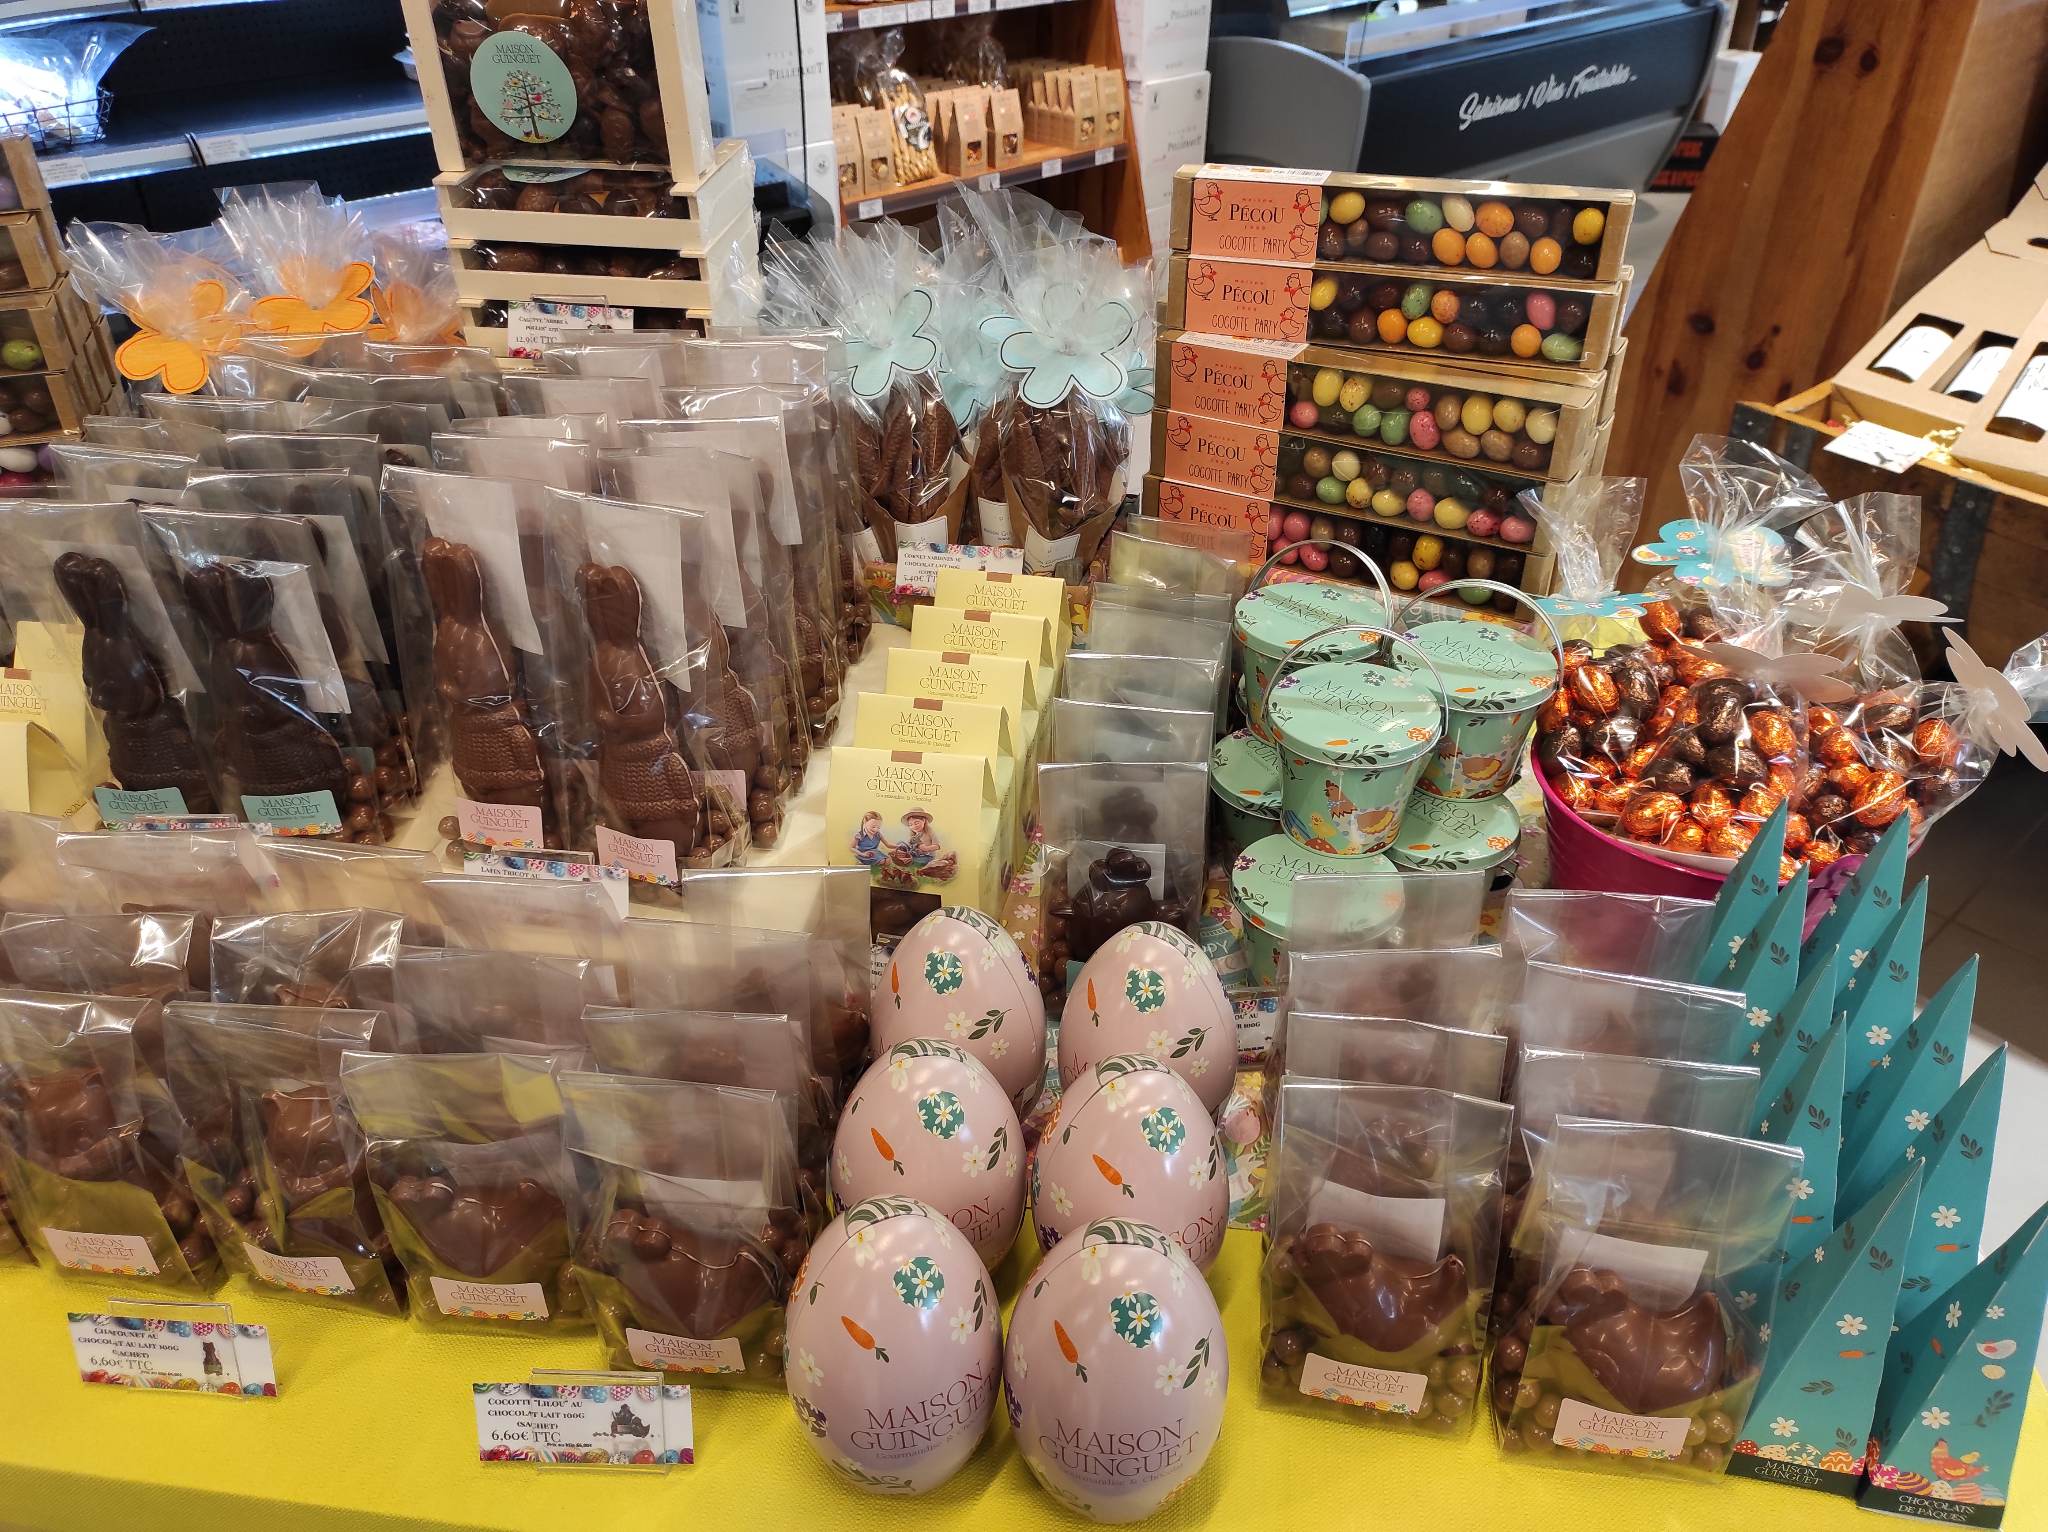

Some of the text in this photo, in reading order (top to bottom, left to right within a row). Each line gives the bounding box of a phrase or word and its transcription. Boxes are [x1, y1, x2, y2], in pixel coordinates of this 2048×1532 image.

[494, 43, 535, 54] MAISON
[492, 53, 541, 64] GUINGUET
[1229, 203, 1285, 223] PÉCOU
[1219, 235, 1288, 255] COCOTTE PARTY
[1223, 285, 1275, 306] PÉCOU
[1212, 314, 1278, 335] COCOTTE PARTY
[1203, 367, 1254, 391] PÉCOU
[1194, 395, 1258, 419] COCOTTE PARTY
[1188, 463, 1250, 489] COCOTTE PARTY
[974, 583, 1022, 599] MAISON
[966, 595, 1027, 611] GUINGUET
[951, 622, 1001, 638] MAISON
[943, 634, 1007, 651] GUINGUET
[1419, 640, 1526, 681] GUINGUET
[1442, 636, 1523, 669] MAISON
[928, 665, 981, 682] MAISON
[919, 677, 988, 695] GUINGUET
[1320, 679, 1405, 718] MAISON
[900, 711, 955, 728] MAISON
[890, 723, 961, 743] GUINGUET
[876, 765, 934, 782] MAISON
[866, 778, 942, 797] GUINGUET
[112, 791, 159, 803] MAISON
[260, 795, 311, 808] MAISON
[109, 800, 168, 812] GUINGUET
[258, 804, 320, 817] GUINGUET
[474, 805, 523, 819] MAISON
[470, 814, 531, 829] GUINGUET
[611, 834, 654, 853] MAISON
[608, 843, 662, 864] GUINGUET
[503, 870, 529, 878] TRICOT
[65, 1242, 135, 1257] GUINGUET
[68, 1236, 125, 1248] MAISON
[264, 1254, 319, 1270] MAISON
[450, 1292, 528, 1304] GUINGUET
[456, 1284, 518, 1296] MAISON
[78, 1336, 123, 1348] CHOCOLAT
[645, 1343, 724, 1358] GUINGUET
[652, 1336, 712, 1351] MAISON
[124, 1359, 154, 1371] TTC
[1336, 1365, 1402, 1383] MAISON
[1323, 1372, 1409, 1394] GUINGUET
[864, 1360, 983, 1431] MAISON
[1592, 1412, 1662, 1430] MAISON
[532, 1431, 562, 1443] TTC
[1055, 1418, 1184, 1456] MAISON
[1578, 1420, 1668, 1440] GUINGUET
[1038, 1432, 1200, 1477] GUINGUET
[1754, 1466, 1823, 1485] GUINGUET
[1764, 1459, 1818, 1478] MAISON
[1898, 1494, 1976, 1514] CHOCOLATS
[1898, 1504, 1916, 1514] DE
